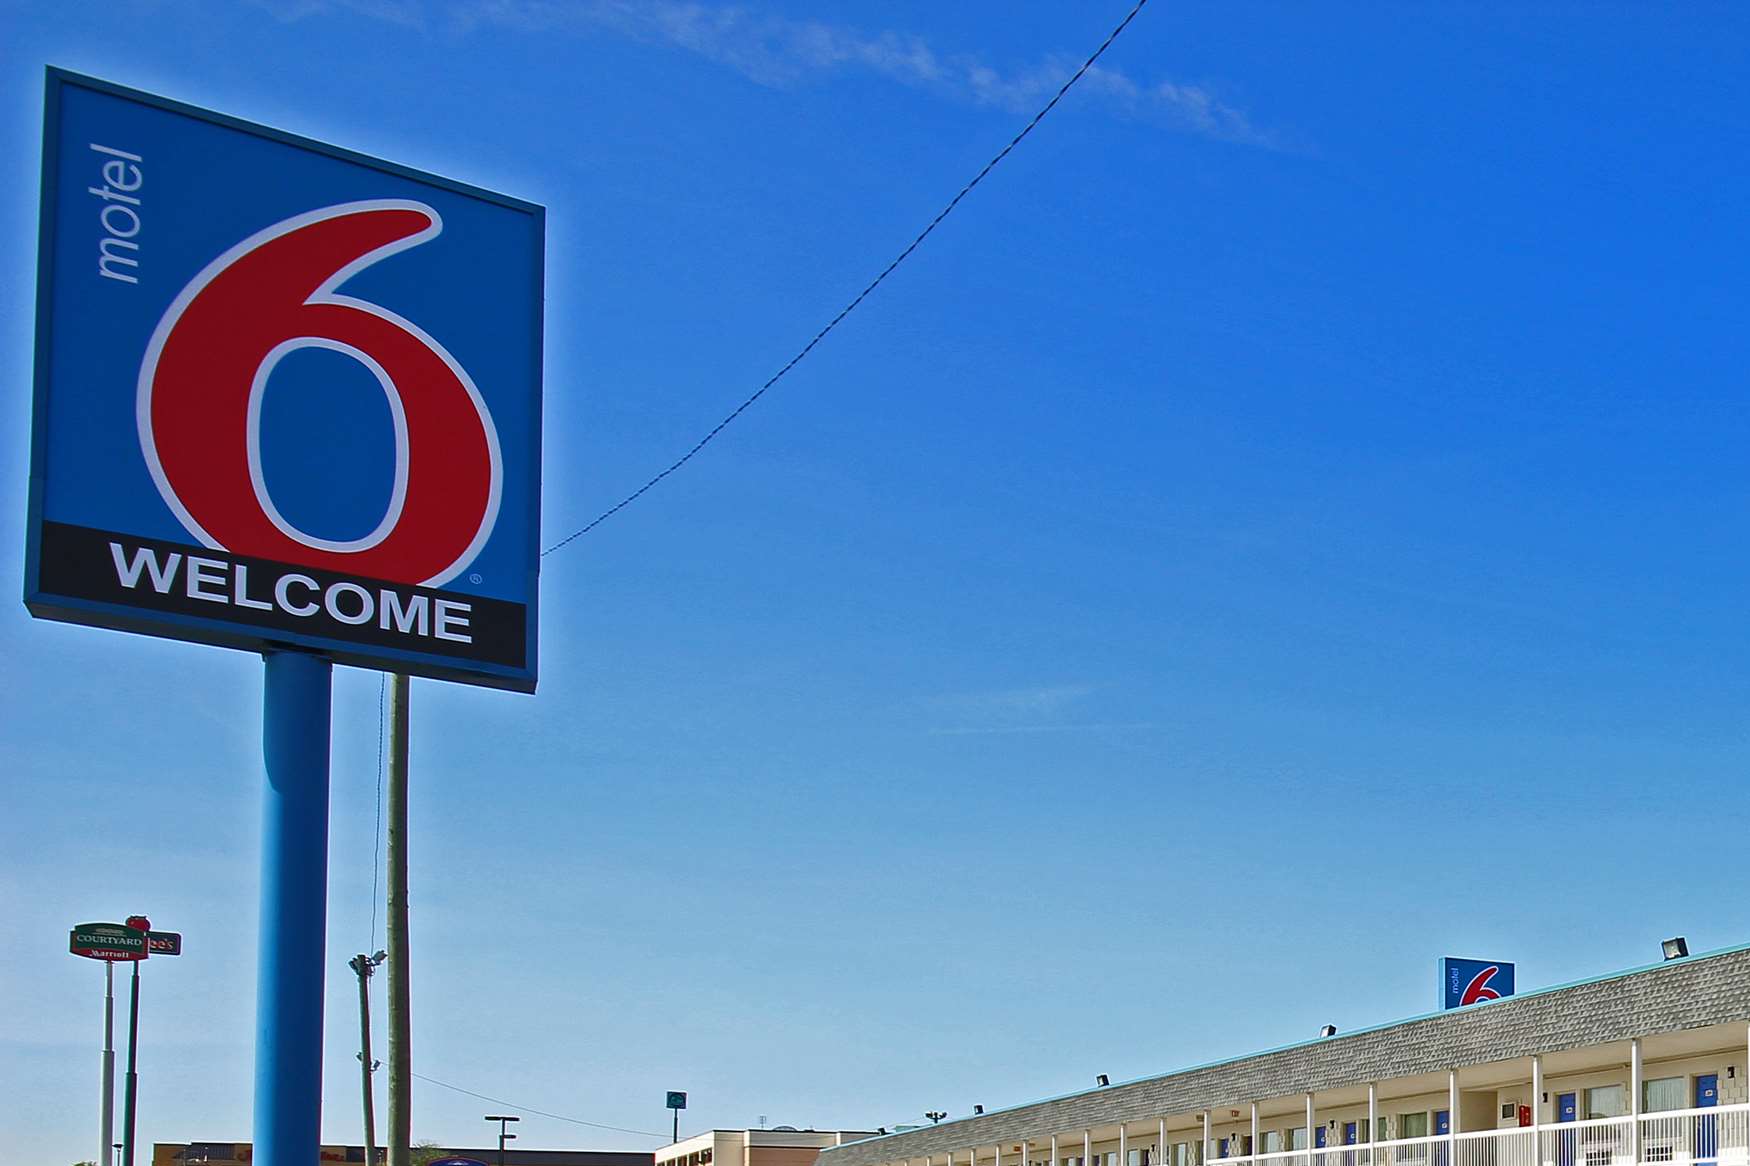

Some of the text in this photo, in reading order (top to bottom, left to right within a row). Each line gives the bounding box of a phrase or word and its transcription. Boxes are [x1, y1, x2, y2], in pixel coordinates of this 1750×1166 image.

[88, 143, 142, 283] motel
[136, 198, 503, 588] 6
[109, 541, 473, 643] WELCOME
[77, 935, 142, 946] COURTYARD
[89, 949, 129, 958] Marriott
